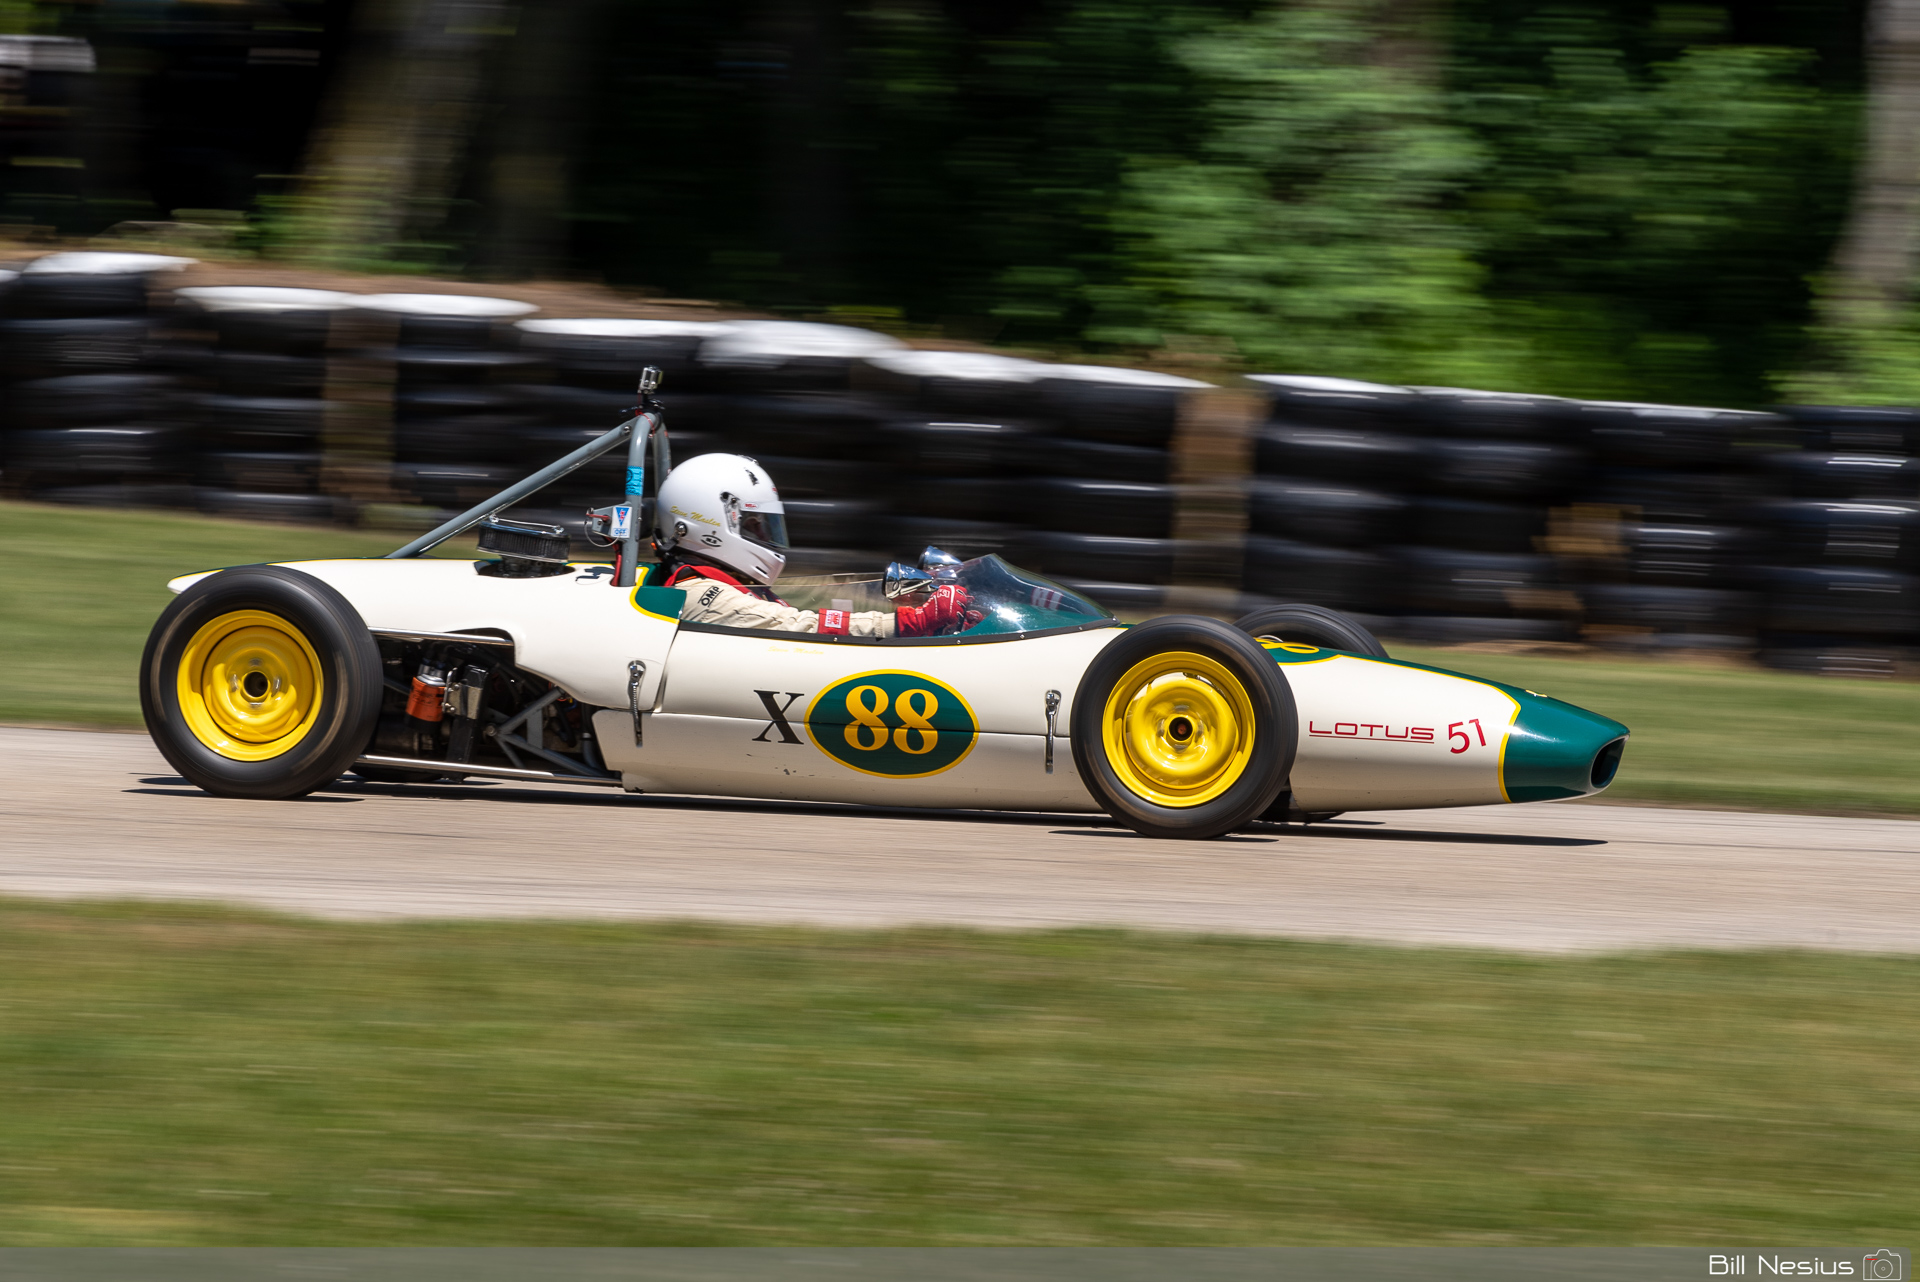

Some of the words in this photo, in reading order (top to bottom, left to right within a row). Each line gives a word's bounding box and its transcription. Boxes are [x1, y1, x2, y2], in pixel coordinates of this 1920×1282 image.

[701, 586, 720, 606] OMP
[751, 689, 805, 745] X
[843, 684, 939, 755] 88
[1308, 720, 1435, 741] LOTUS
[1447, 718, 1487, 754] 51
